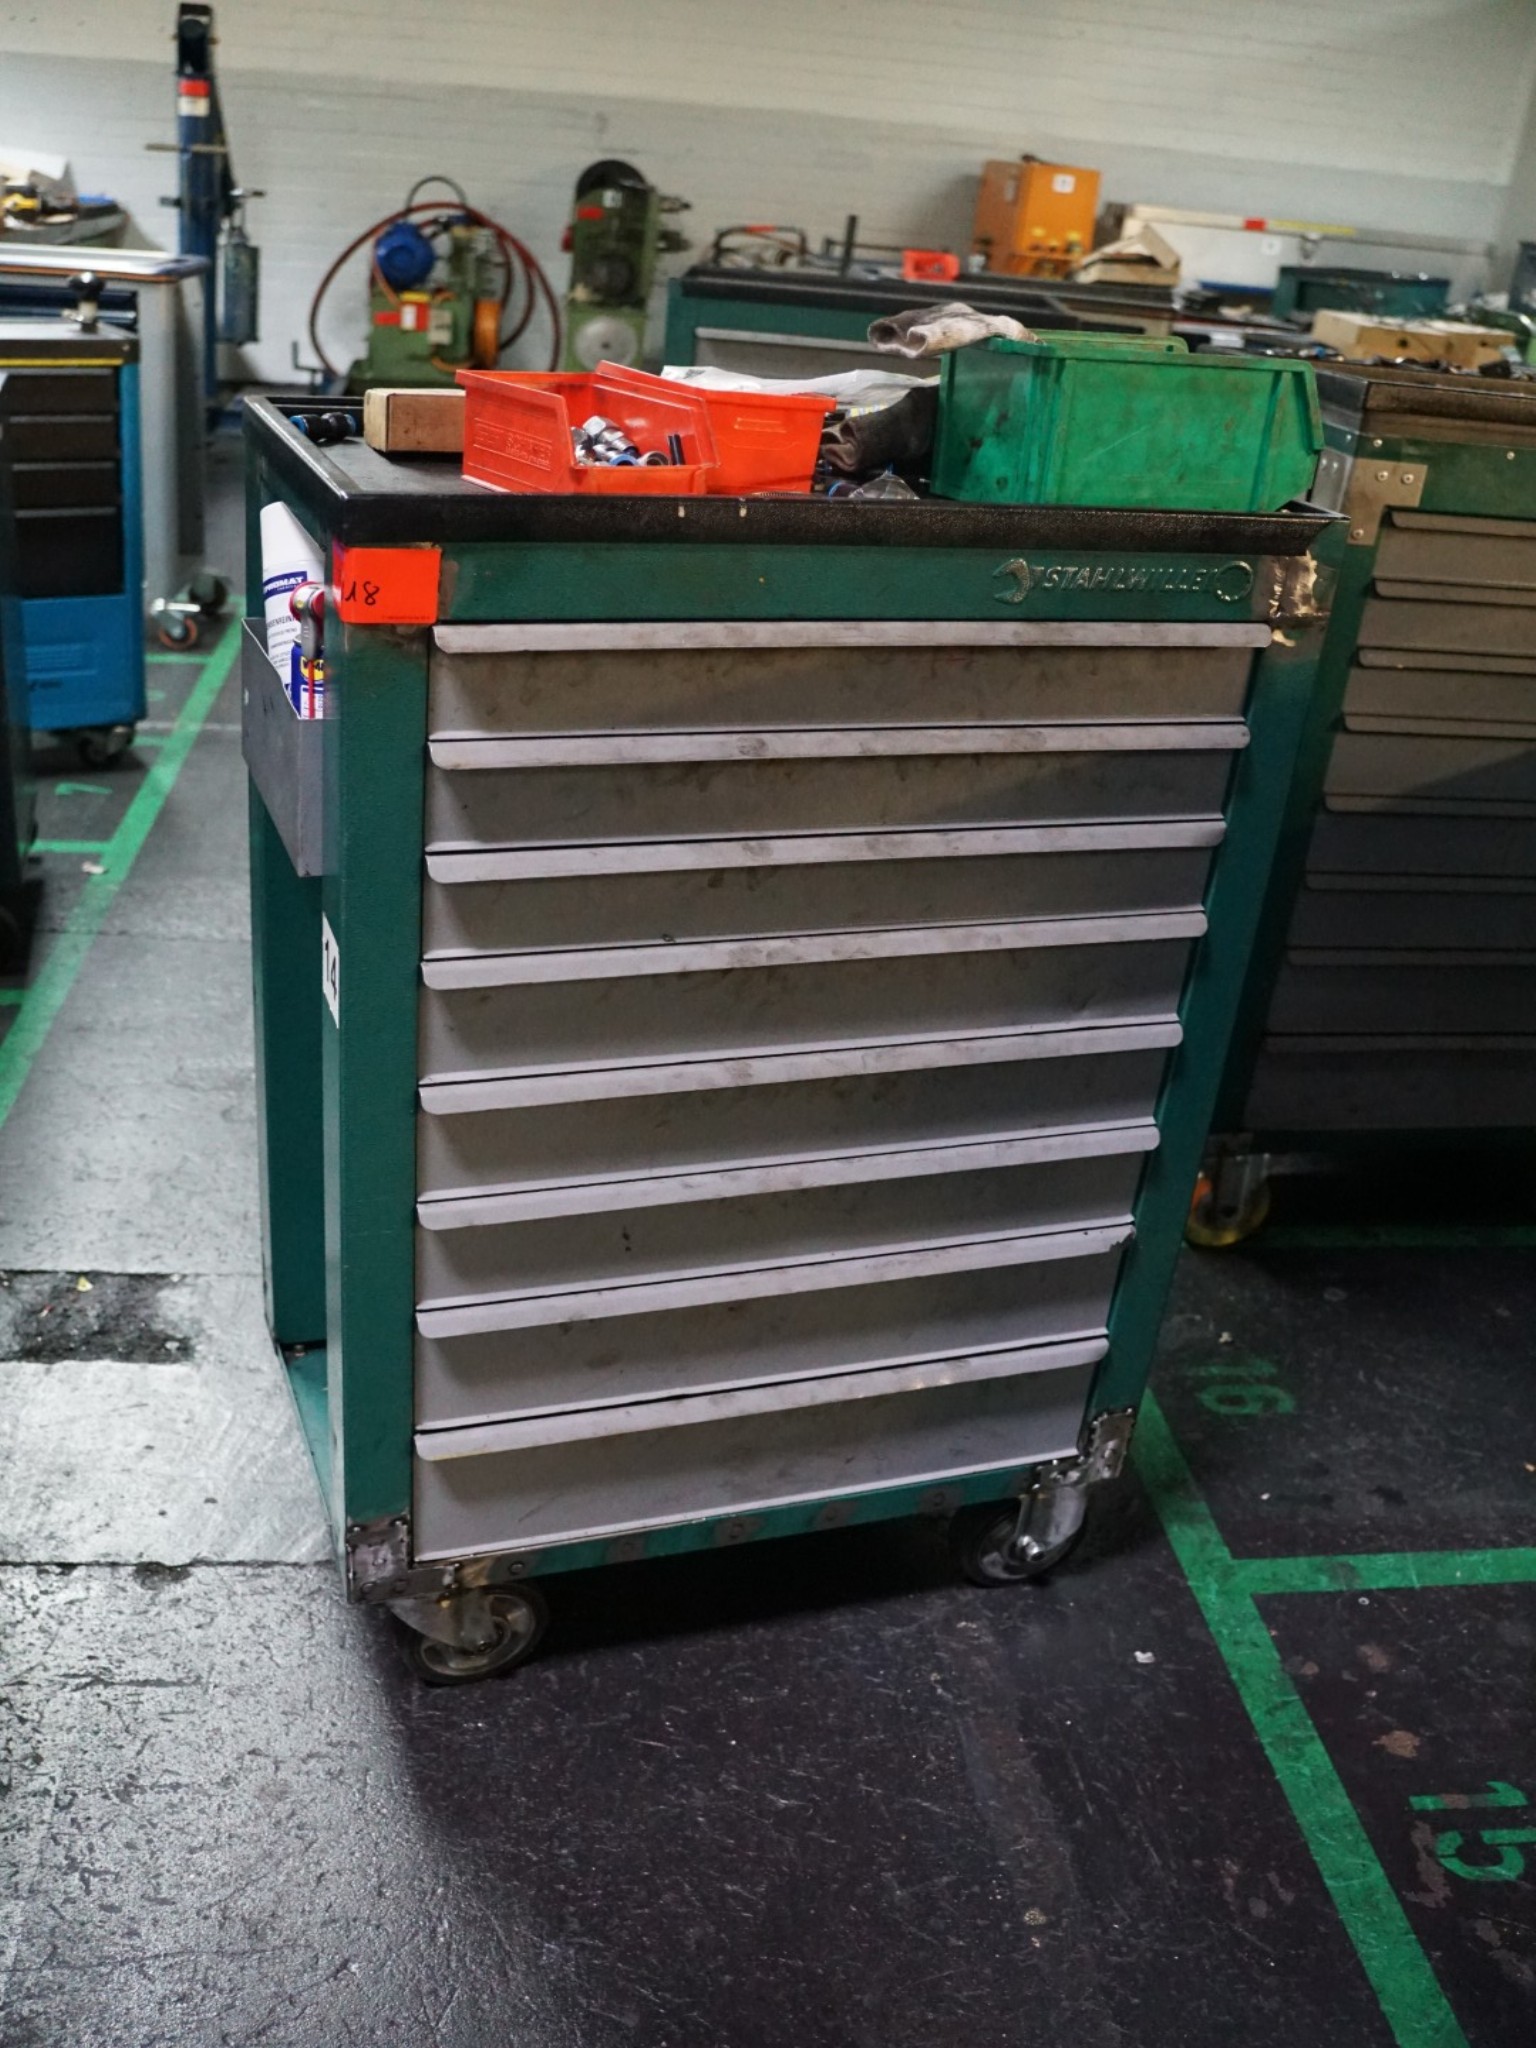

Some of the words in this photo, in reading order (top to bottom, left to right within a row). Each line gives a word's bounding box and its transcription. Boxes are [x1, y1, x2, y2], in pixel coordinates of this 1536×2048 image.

[344, 580, 381, 606] 18
[1043, 565, 1208, 592] STAHLWILLE
[325, 939, 338, 1001] 14
[1187, 1359, 1296, 1416] 16
